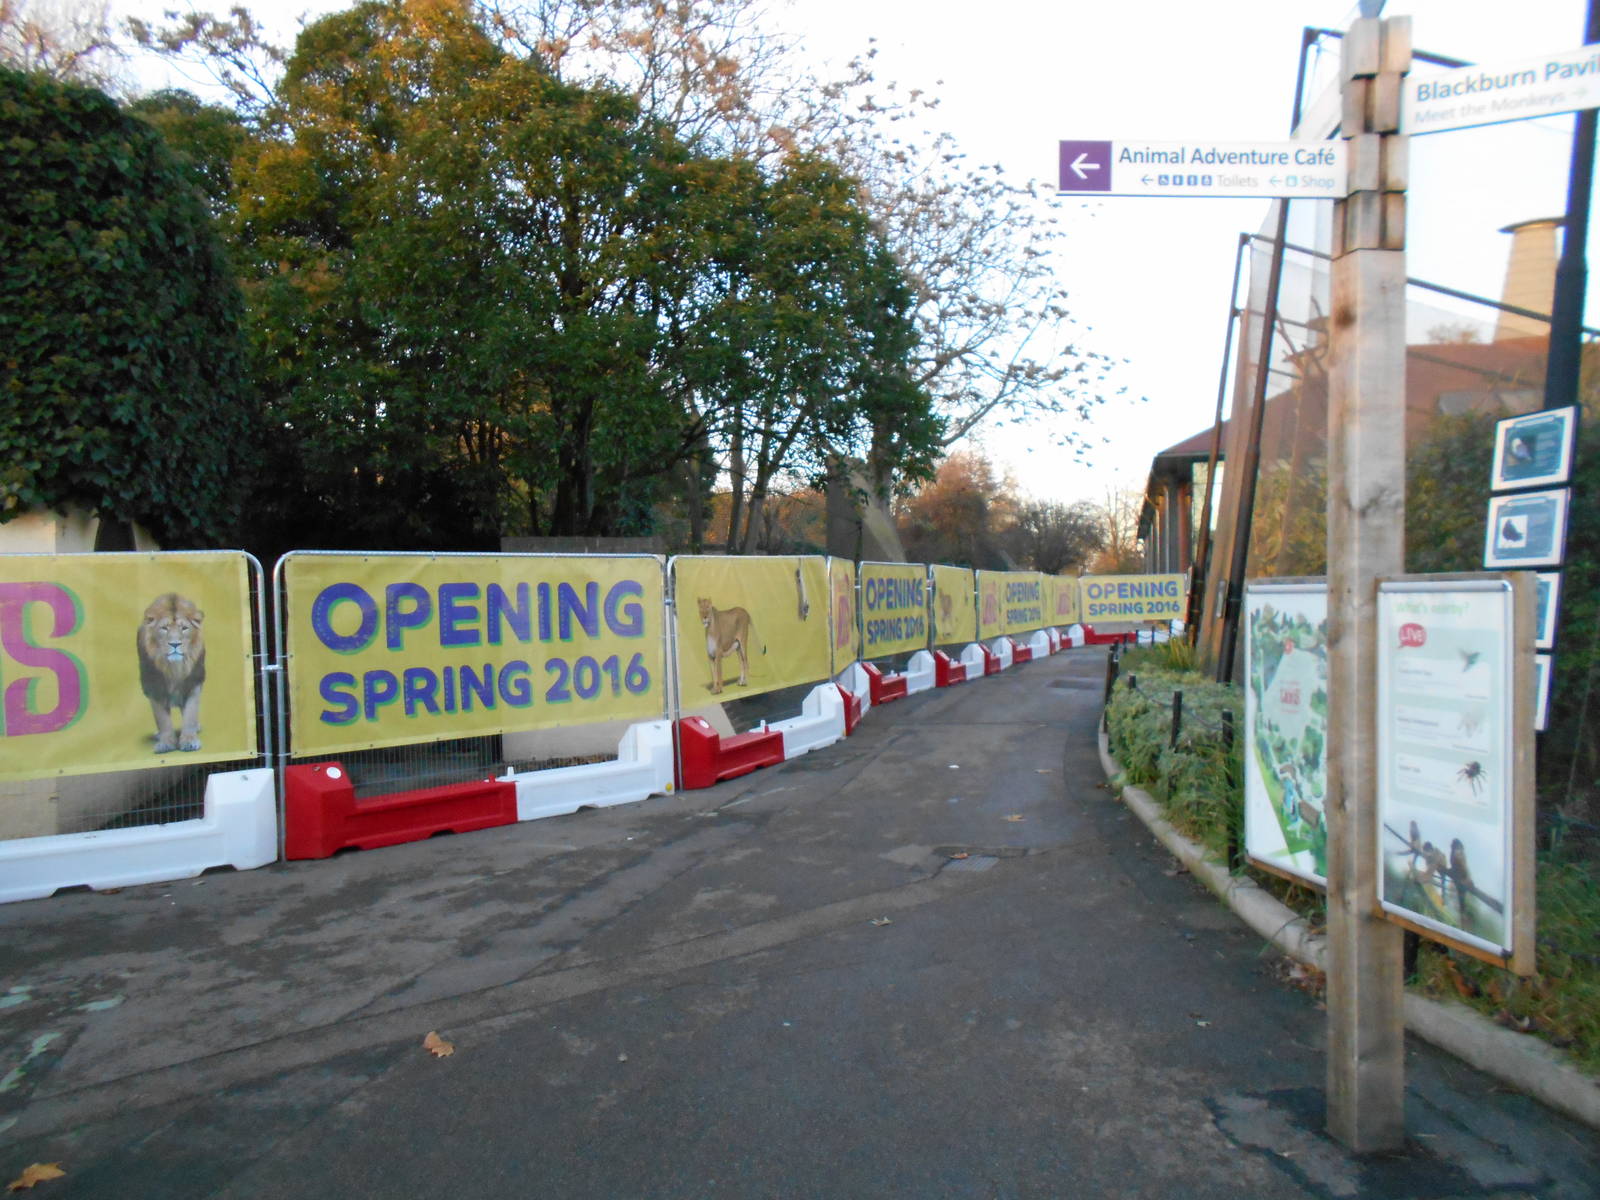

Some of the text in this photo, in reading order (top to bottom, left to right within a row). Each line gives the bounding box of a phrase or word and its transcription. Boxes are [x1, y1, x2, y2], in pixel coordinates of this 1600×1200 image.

[1417, 68, 1536, 102] Blackburn
[1415, 92, 1565, 123] Meet the Monkeys
[1119, 147, 1336, 166] Animal Adventure Café
[1217, 174, 1335, 190] Toilets Shop
[866, 577, 924, 610] OPENING
[1006, 581, 1040, 603] OPENING
[1087, 581, 1179, 601] OPENING
[311, 579, 646, 654] OPENING
[1088, 600, 1181, 617] SPRING 2016
[867, 616, 925, 645] SPRING 2016
[1400, 627, 1425, 643] LIVE
[319, 652, 651, 727] SPRING 2016
